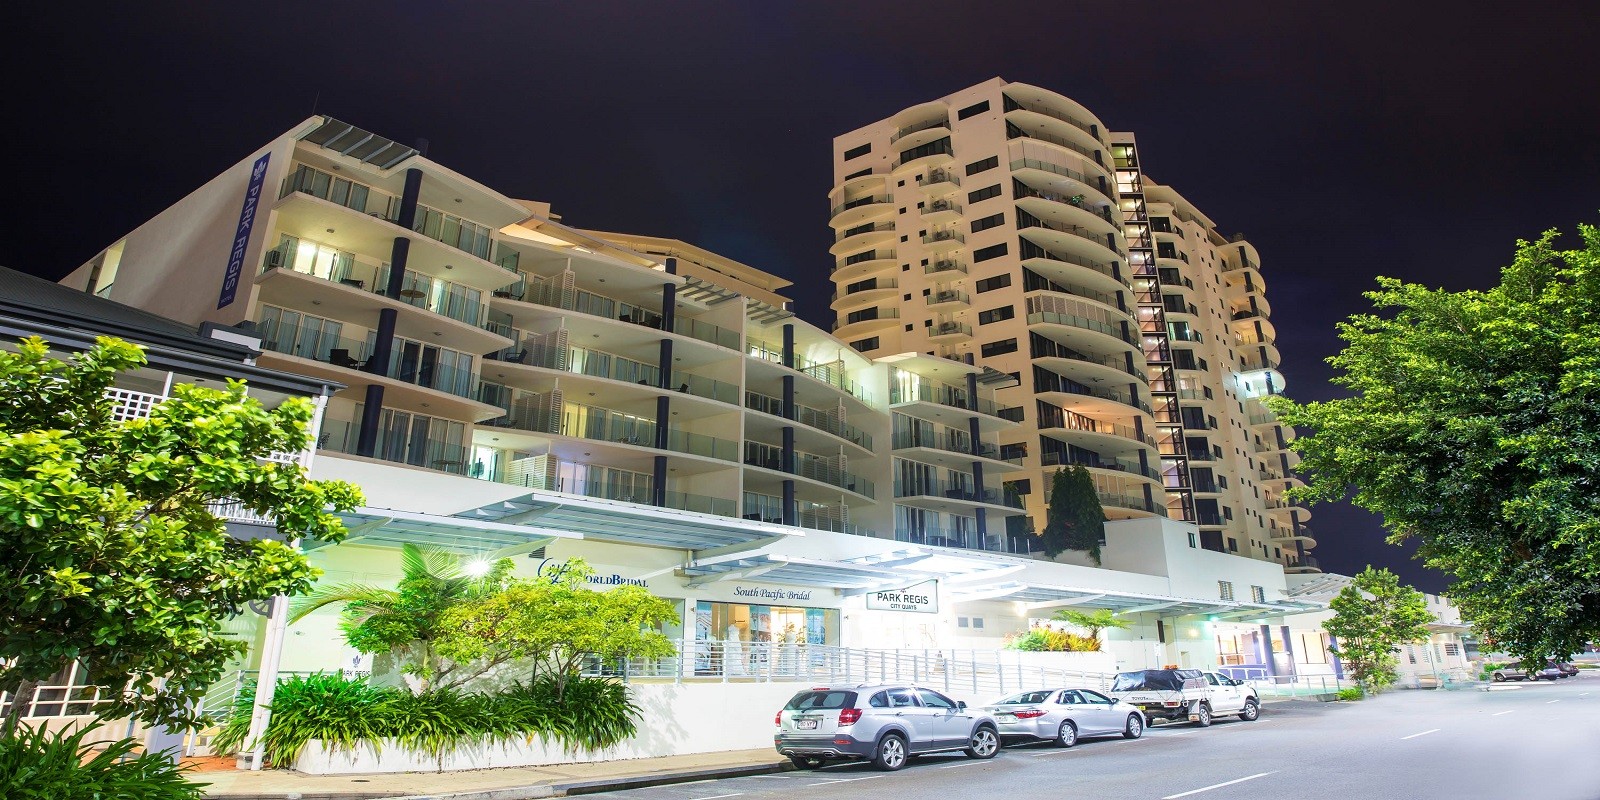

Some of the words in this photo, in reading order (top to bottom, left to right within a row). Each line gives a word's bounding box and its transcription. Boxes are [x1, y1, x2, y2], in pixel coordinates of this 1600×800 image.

[239, 184, 260, 233] PARK
[225, 235, 247, 291] REGIS
[585, 574, 649, 588] ORLDBRIDAL
[733, 586, 759, 597] South
[760, 588, 786, 601] Pacific
[787, 590, 812, 600] Bridal
[877, 592, 901, 602] PARK
[903, 594, 929, 605] REGIS
